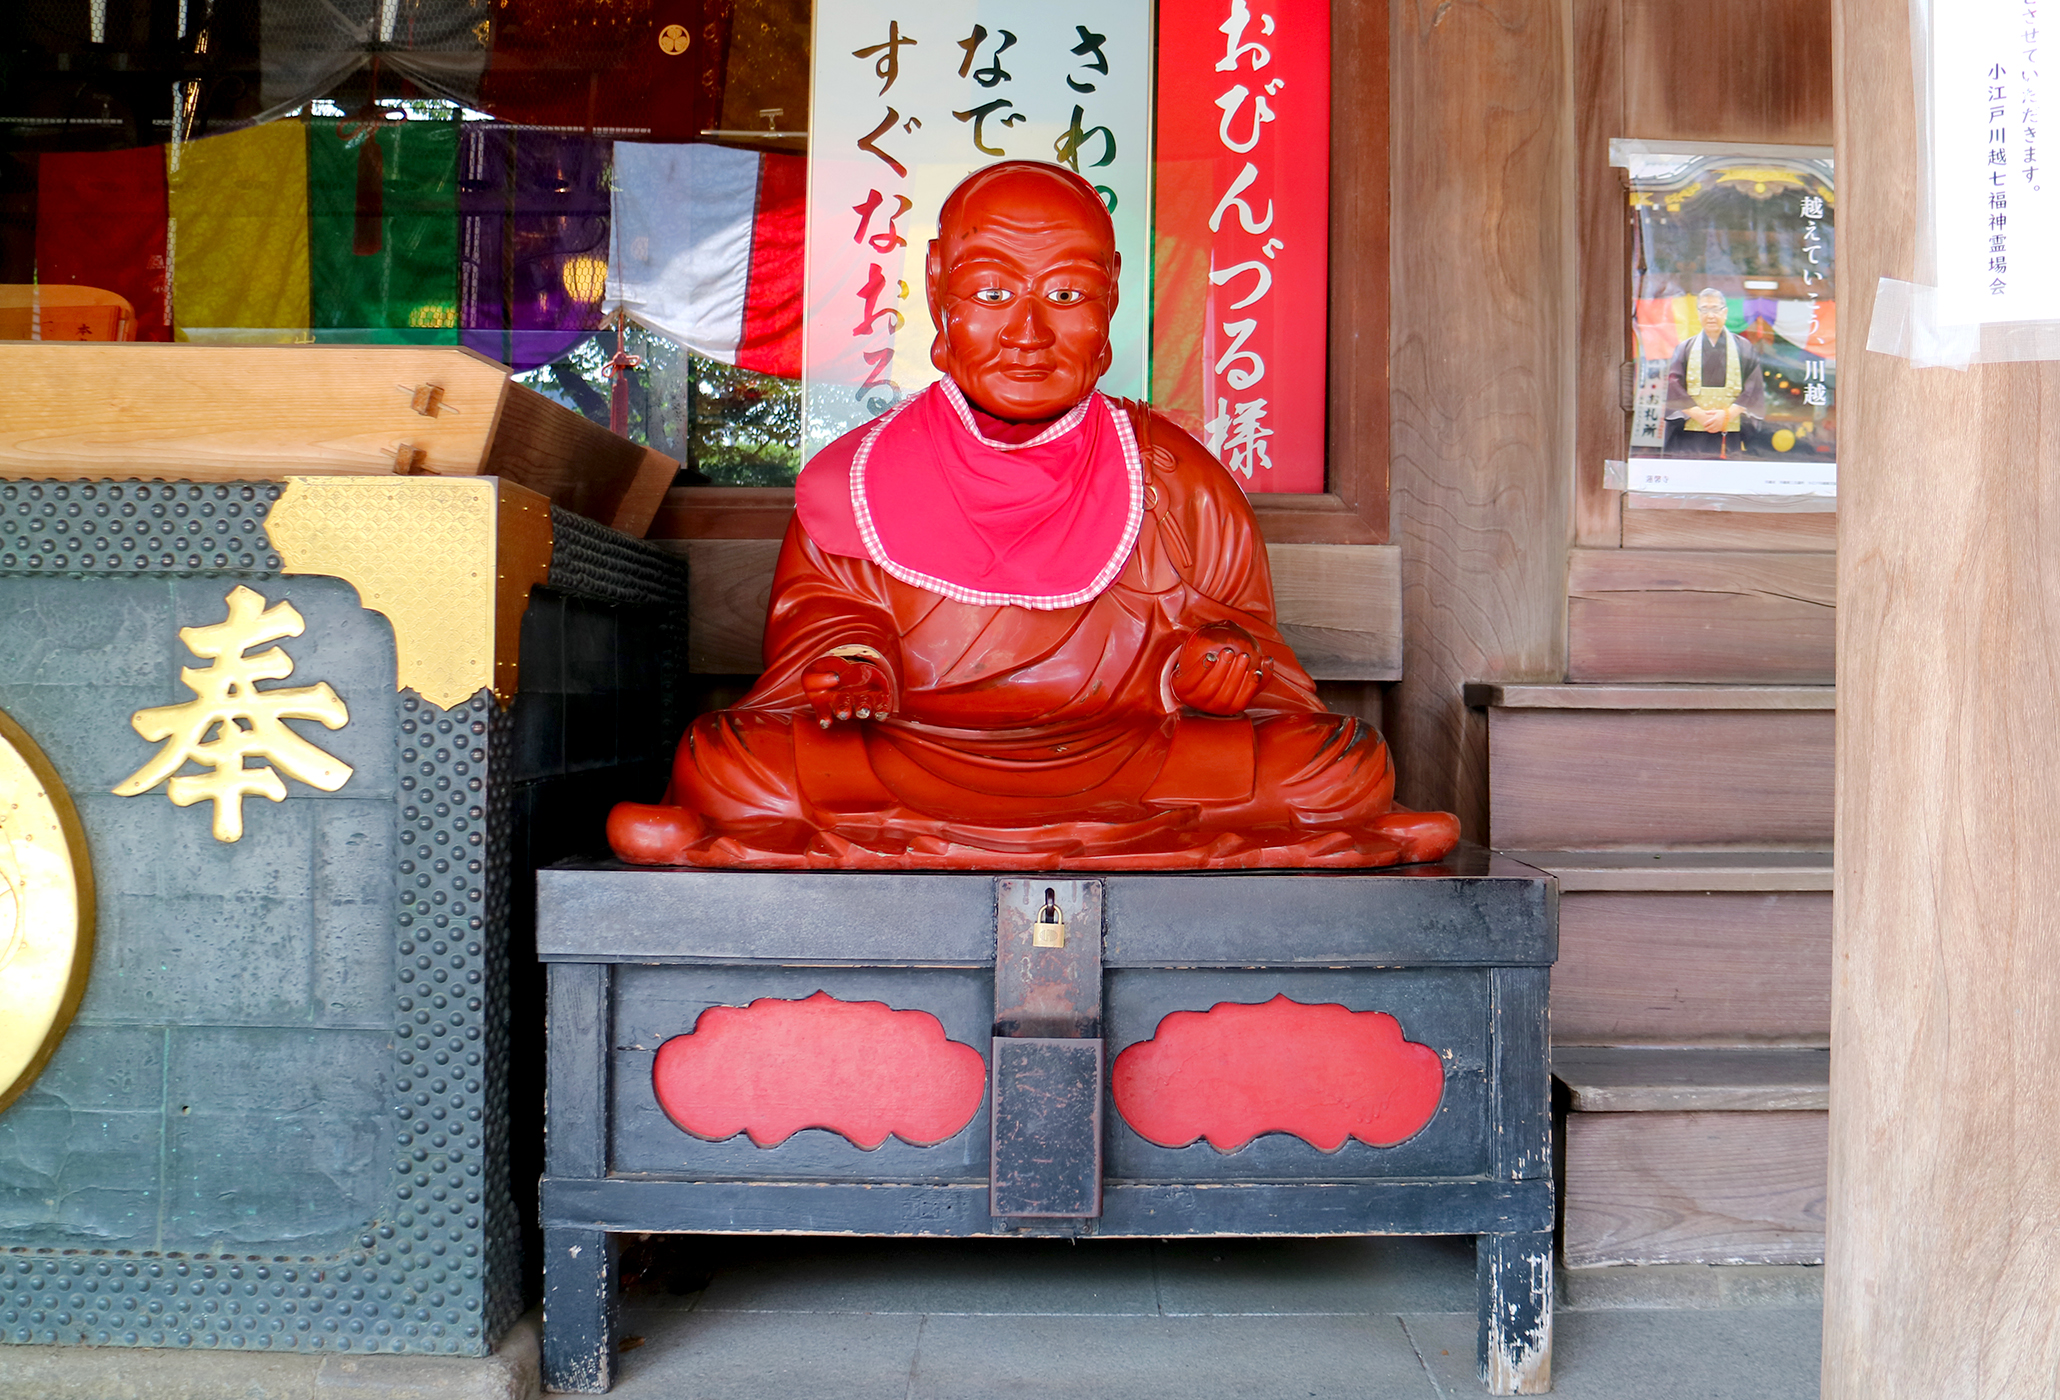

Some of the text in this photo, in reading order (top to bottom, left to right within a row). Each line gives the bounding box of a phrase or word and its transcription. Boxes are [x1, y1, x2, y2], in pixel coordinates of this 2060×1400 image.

[952, 23, 1026, 174] なで
[1054, 25, 1117, 214] さわ
[1988, 63, 2007, 295] 小江戸川越七福神霊場会
[2021, 0, 2041, 191] させていただきます。
[852, 20, 921, 417] すぐなおる
[1204, 0, 1284, 479] おびんづる様
[1803, 360, 1827, 406] 川越
[111, 585, 354, 842] 奉
